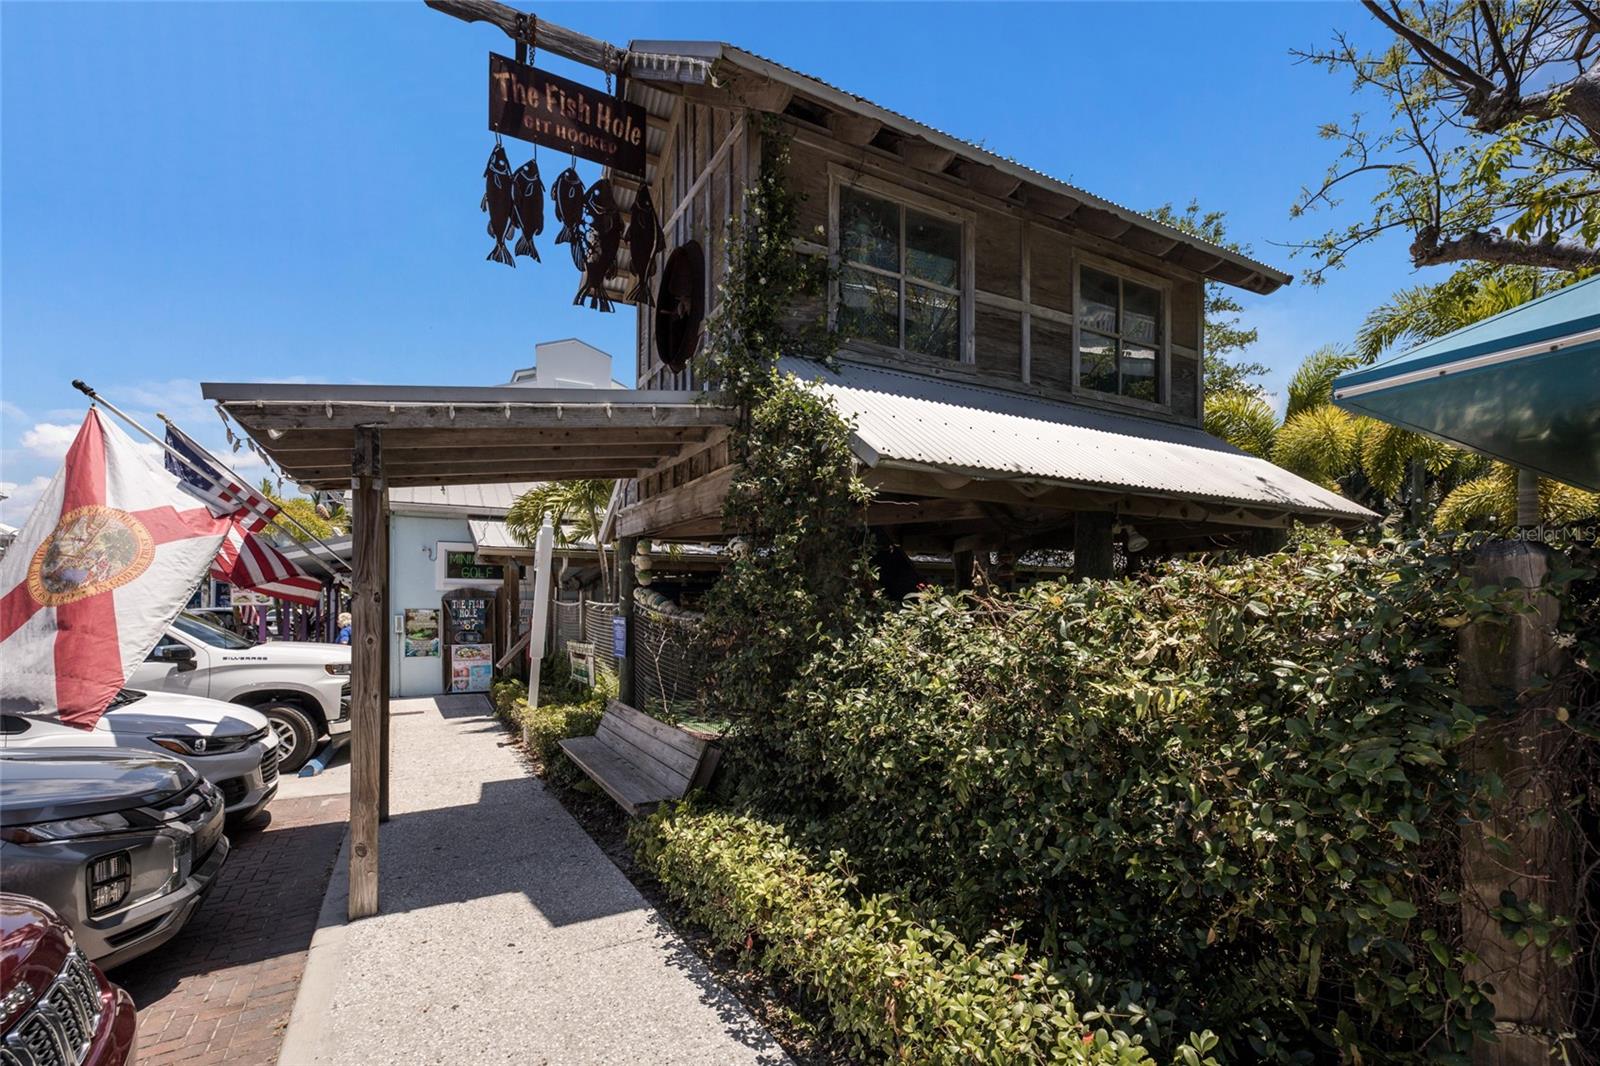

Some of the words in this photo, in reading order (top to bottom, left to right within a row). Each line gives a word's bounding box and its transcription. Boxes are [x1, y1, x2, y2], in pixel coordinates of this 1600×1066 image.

[493, 72, 539, 108] The
[545, 83, 590, 125] Fish
[597, 103, 642, 146] Hole
[461, 567, 493, 578] GOLF
[468, 600, 485, 609] FISH
